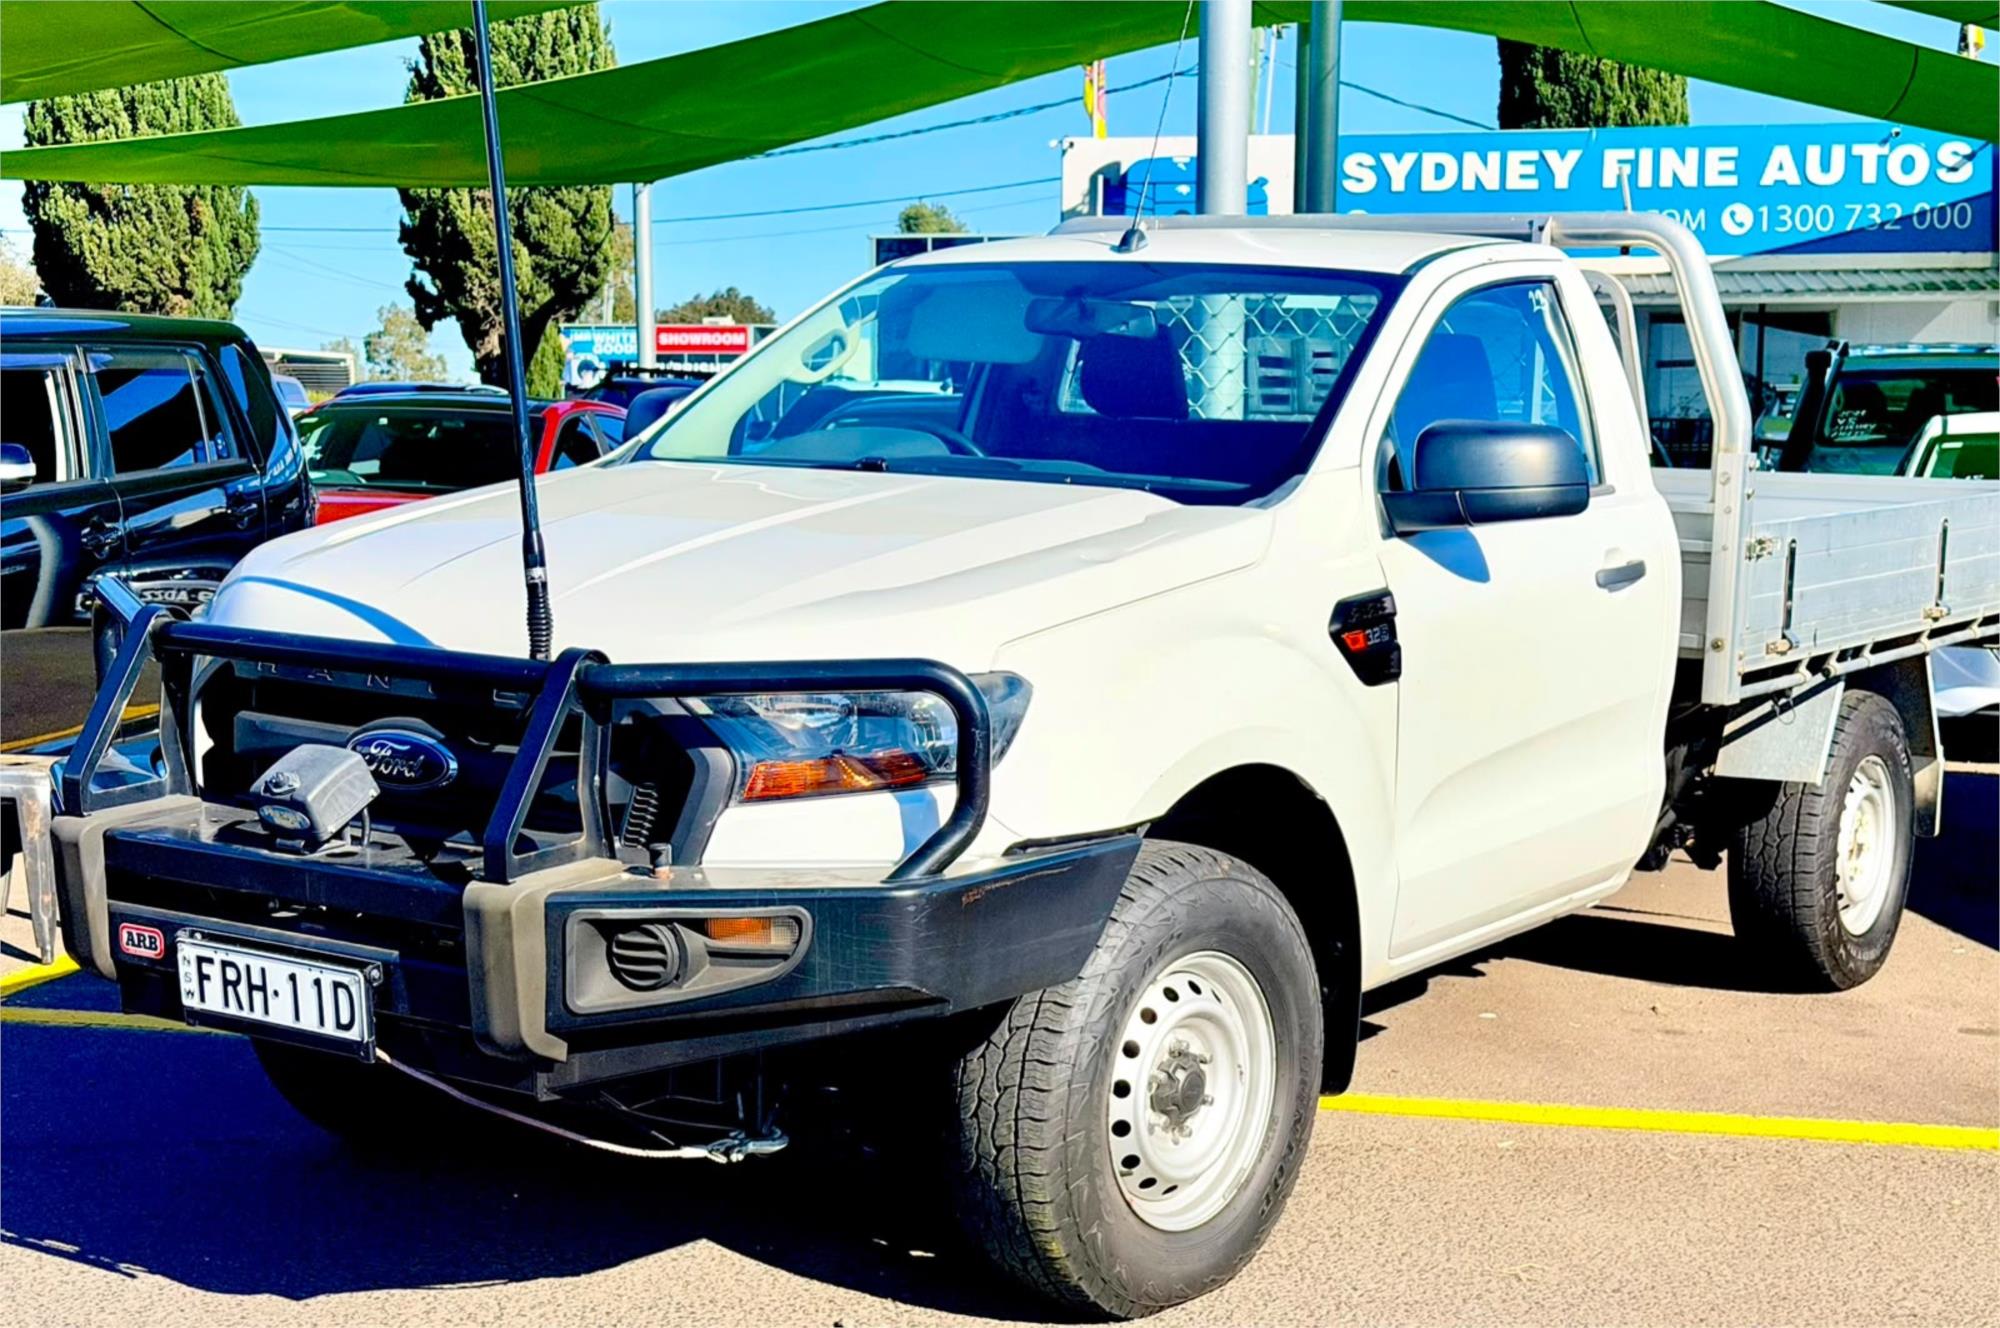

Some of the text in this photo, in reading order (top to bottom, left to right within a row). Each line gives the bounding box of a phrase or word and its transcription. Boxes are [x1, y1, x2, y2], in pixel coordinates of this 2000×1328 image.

[1342, 141, 1974, 193] SYDNEY FINE AUTOS
[1758, 204, 1835, 232] 1300
[1844, 203, 1902, 231] 732
[1912, 201, 1972, 229] 000
[659, 332, 746, 346] SHOWROOM
[365, 739, 425, 778] Ford
[125, 931, 158, 952] ARB
